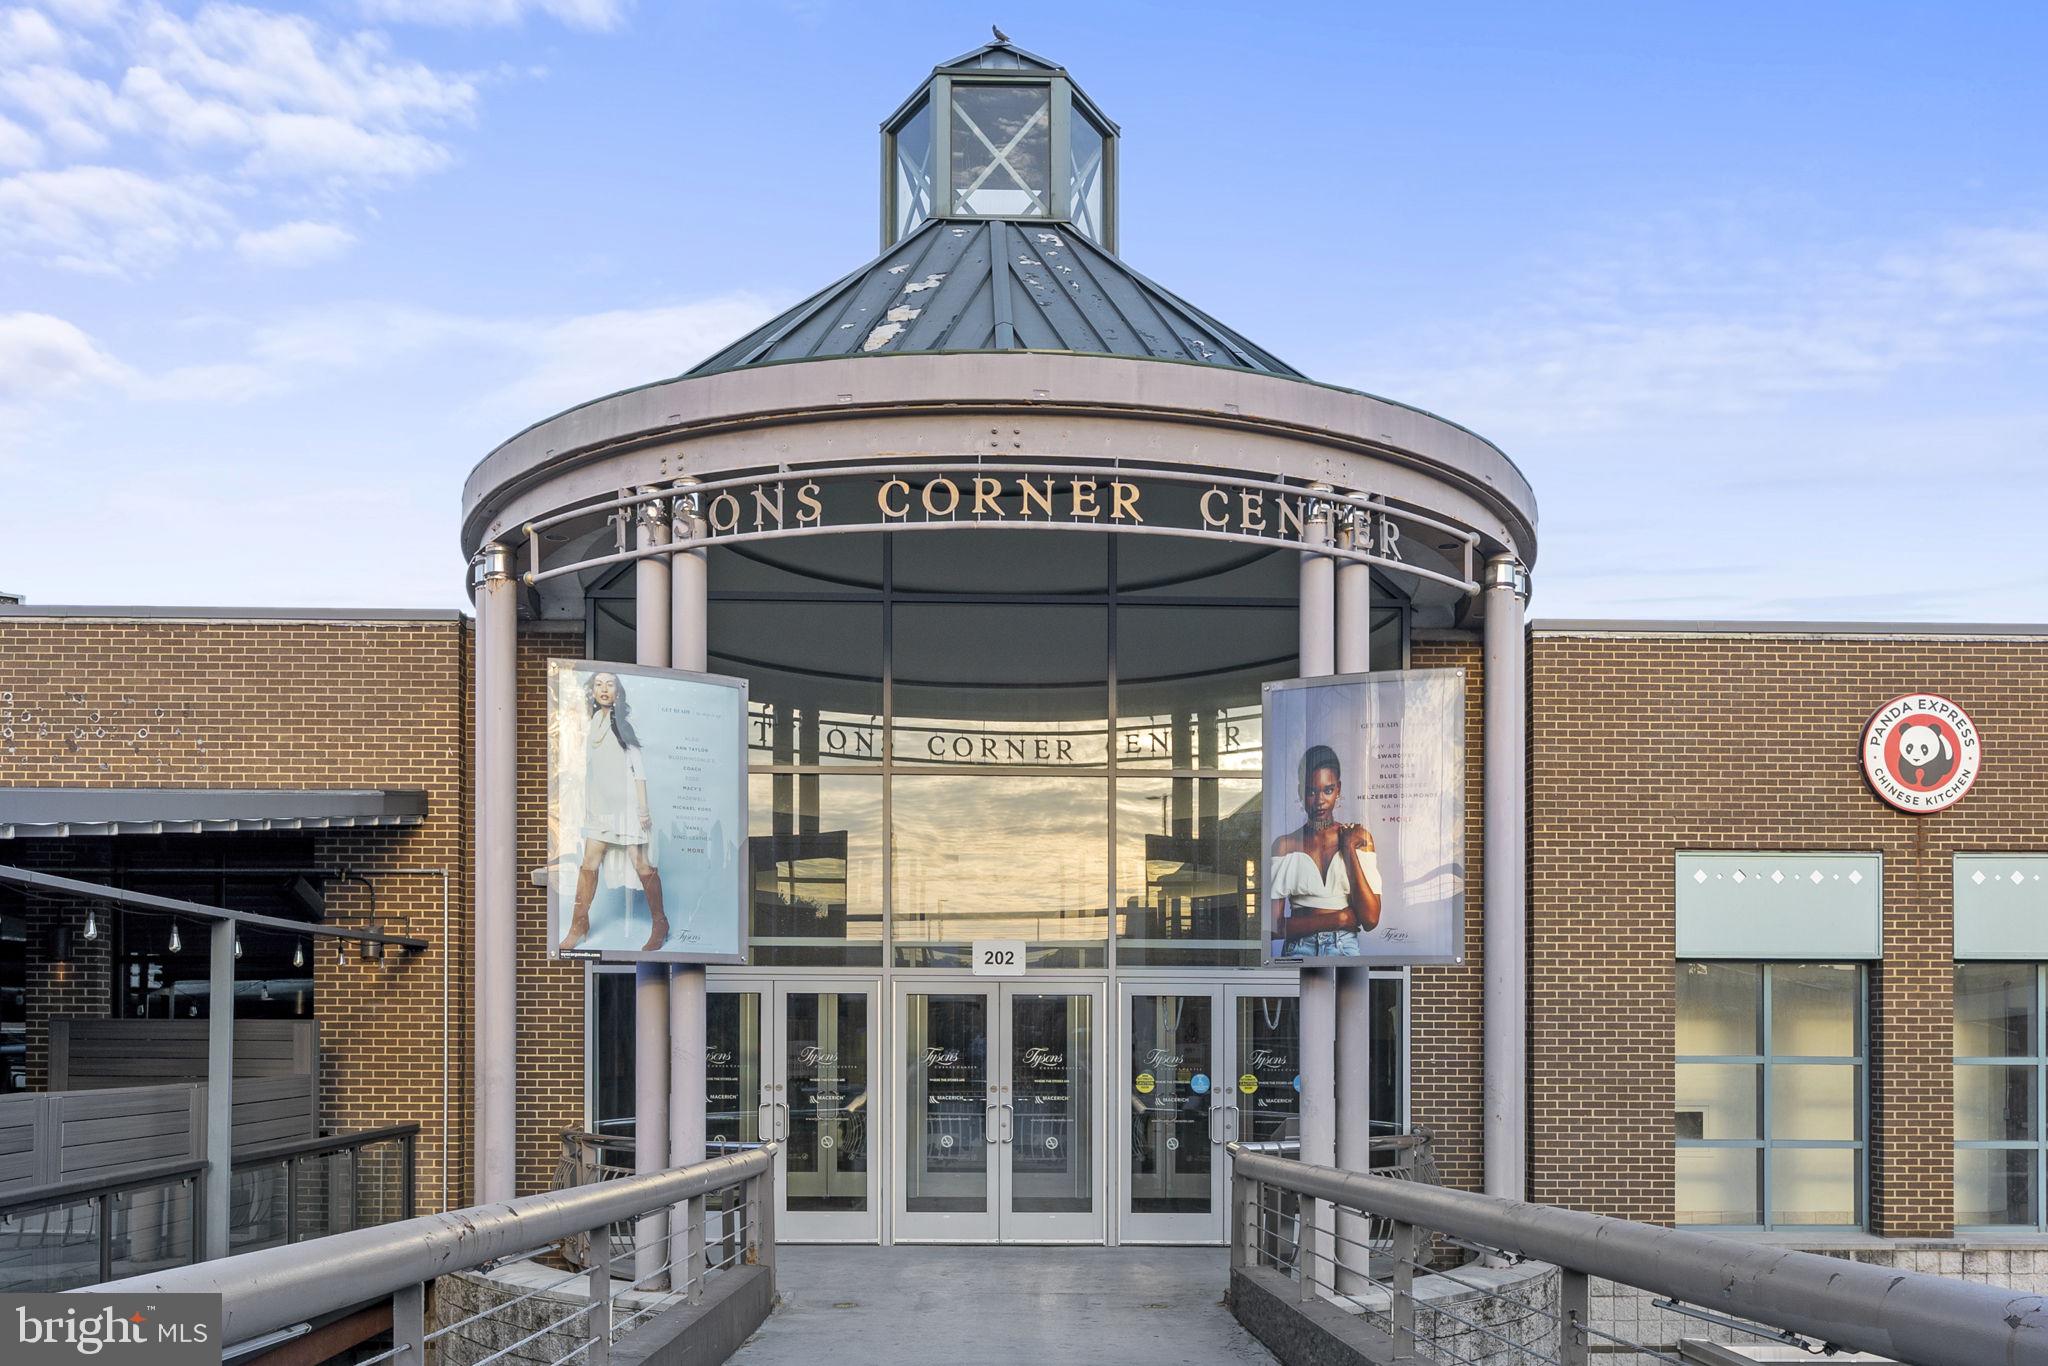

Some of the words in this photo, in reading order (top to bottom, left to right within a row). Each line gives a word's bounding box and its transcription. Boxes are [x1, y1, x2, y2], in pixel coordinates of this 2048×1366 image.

[607, 484, 822, 549] TYSONS
[877, 477, 1144, 522] CORNER
[1200, 489, 1402, 560] CENTER
[1870, 702, 1913, 746] PANDA
[1918, 699, 1975, 747] EXPRESS
[927, 736, 1073, 761] CORNER
[1874, 768, 1920, 806] CHINESE
[1925, 768, 1972, 806] KITCHEN
[984, 950, 1015, 966] 202
[798, 1046, 838, 1066] Tysons
[920, 1047, 960, 1067] Tysons
[1022, 1047, 1063, 1068] Tysons
[1144, 1049, 1184, 1068] Tysons
[1247, 1049, 1287, 1069] Tysons
